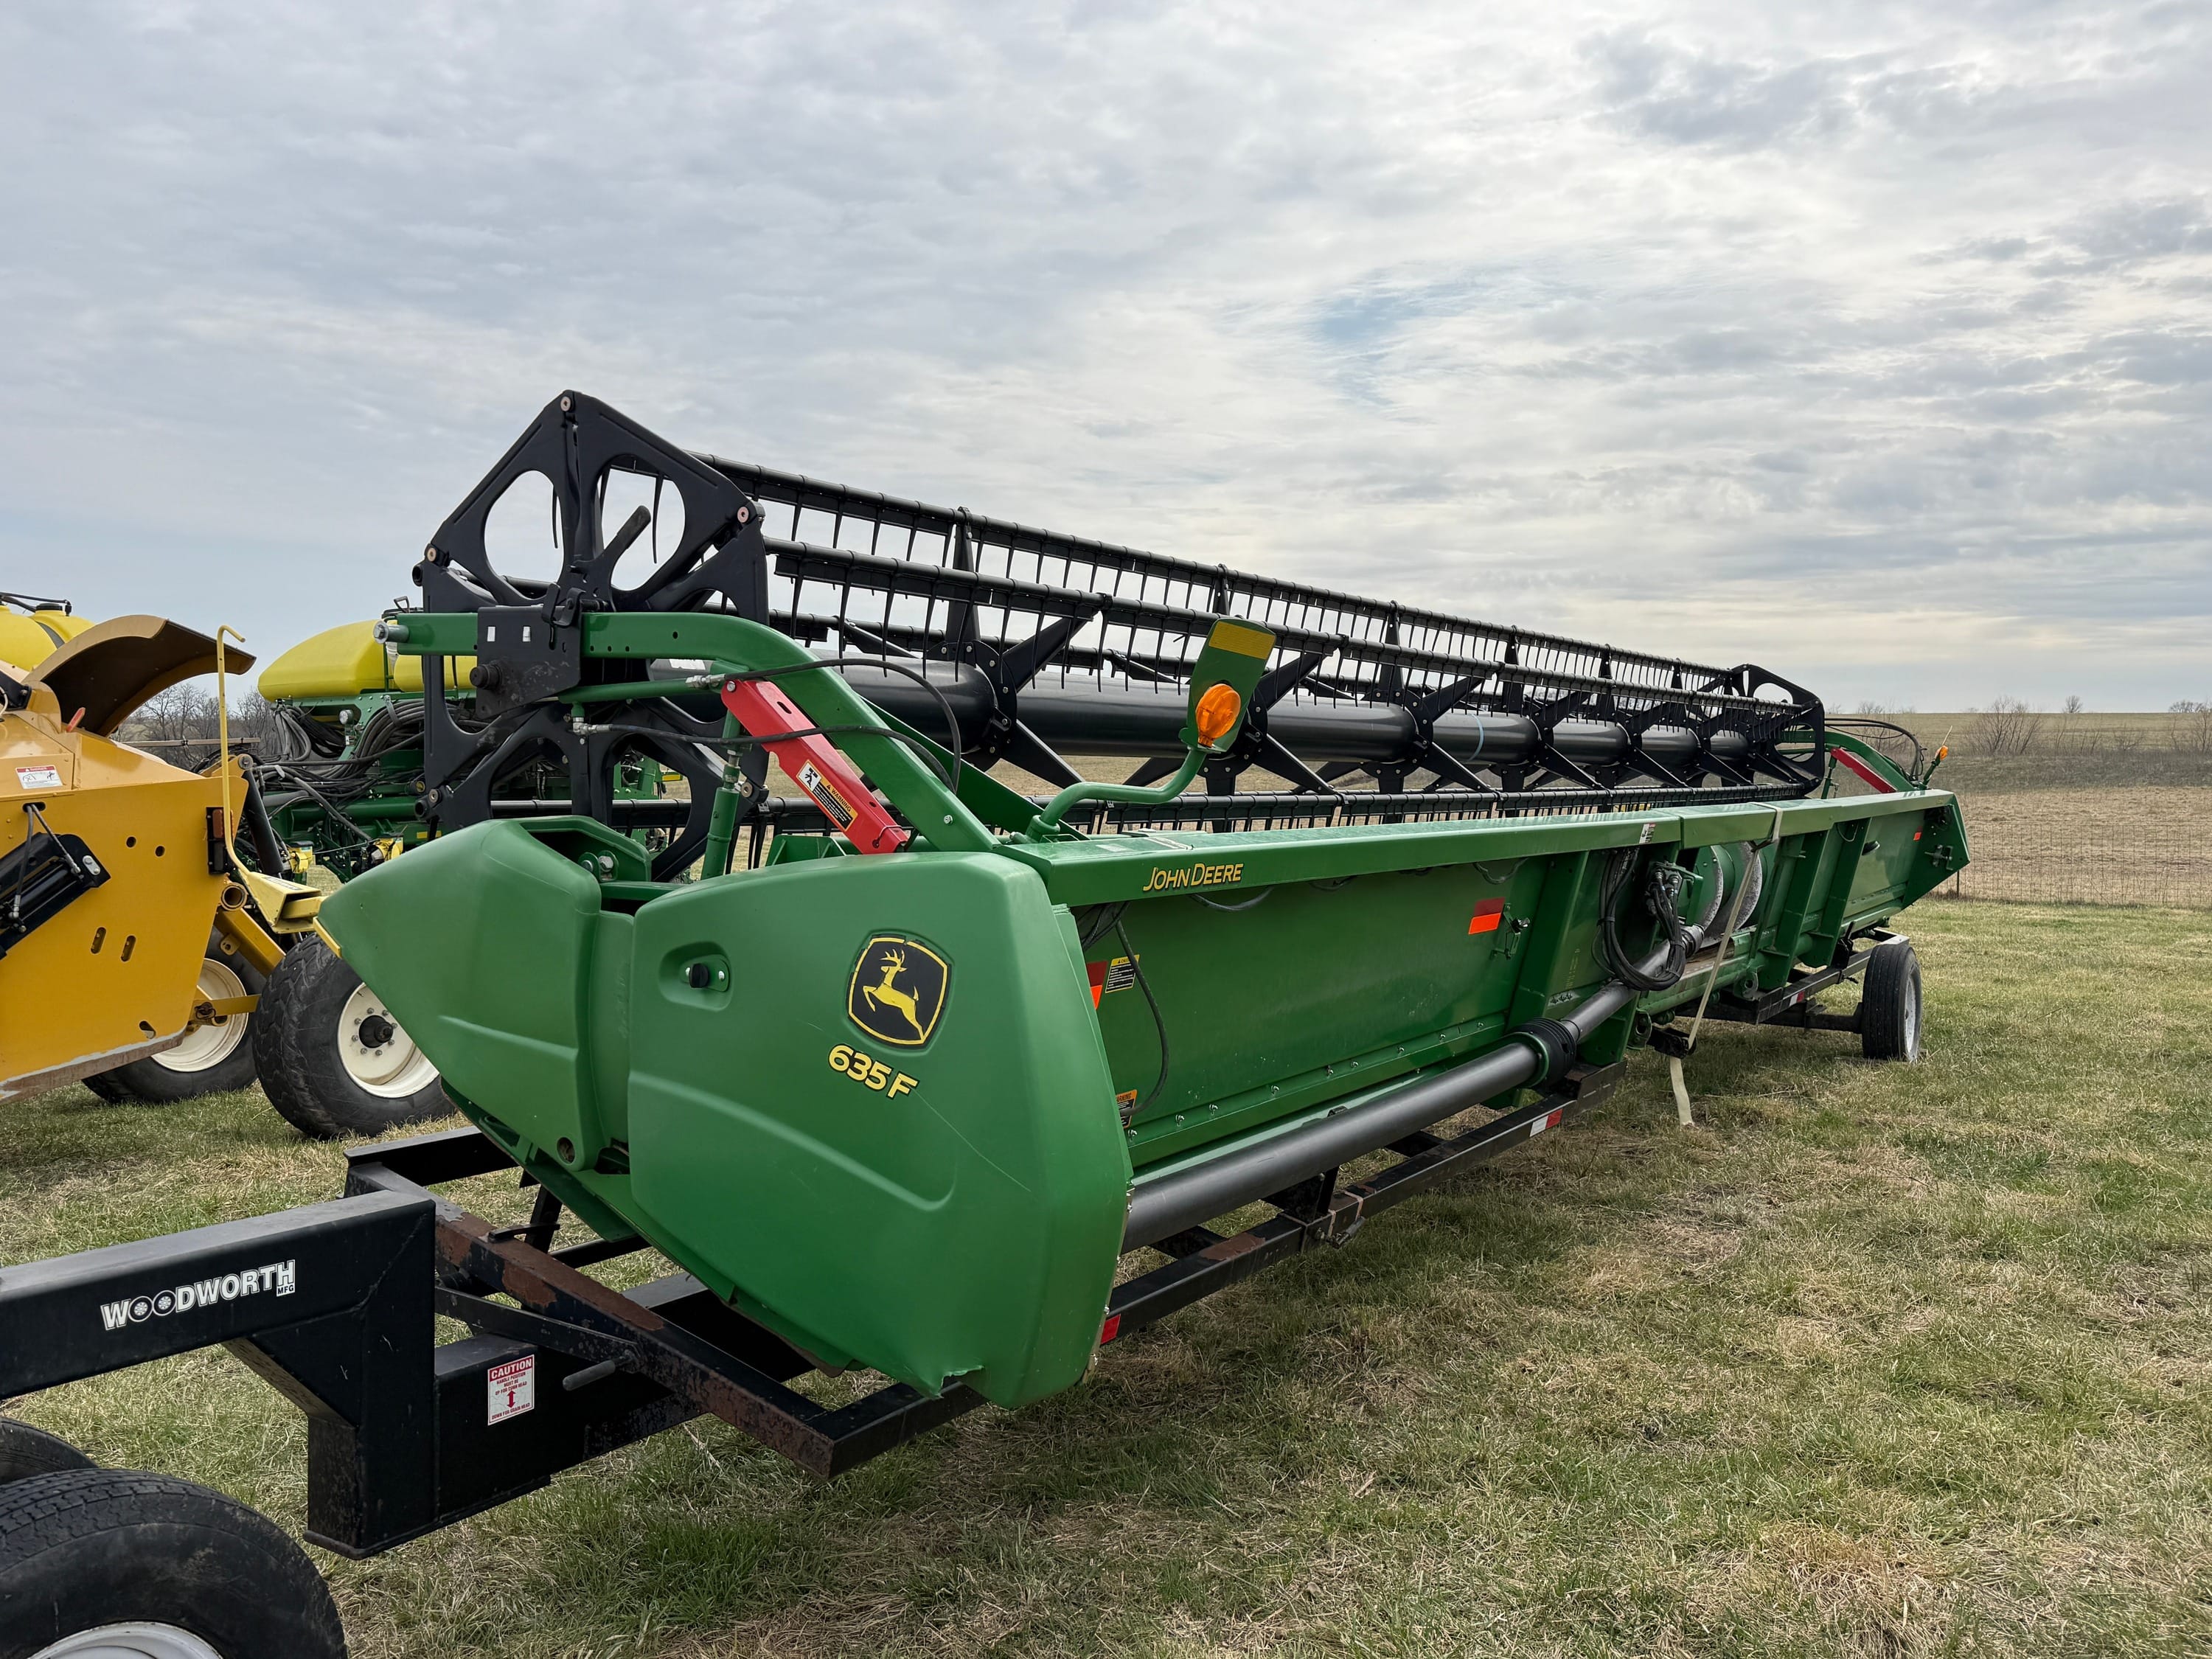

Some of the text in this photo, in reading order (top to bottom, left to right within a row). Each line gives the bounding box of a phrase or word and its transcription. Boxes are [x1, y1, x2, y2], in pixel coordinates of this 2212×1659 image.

[832, 790, 852, 812] WARNING
[1143, 863, 1244, 891] JOHN DEERE
[100, 1259, 295, 1331] WOODWORTH
[277, 1284, 295, 1295] MFG
[491, 1358, 532, 1380] CAUTION
